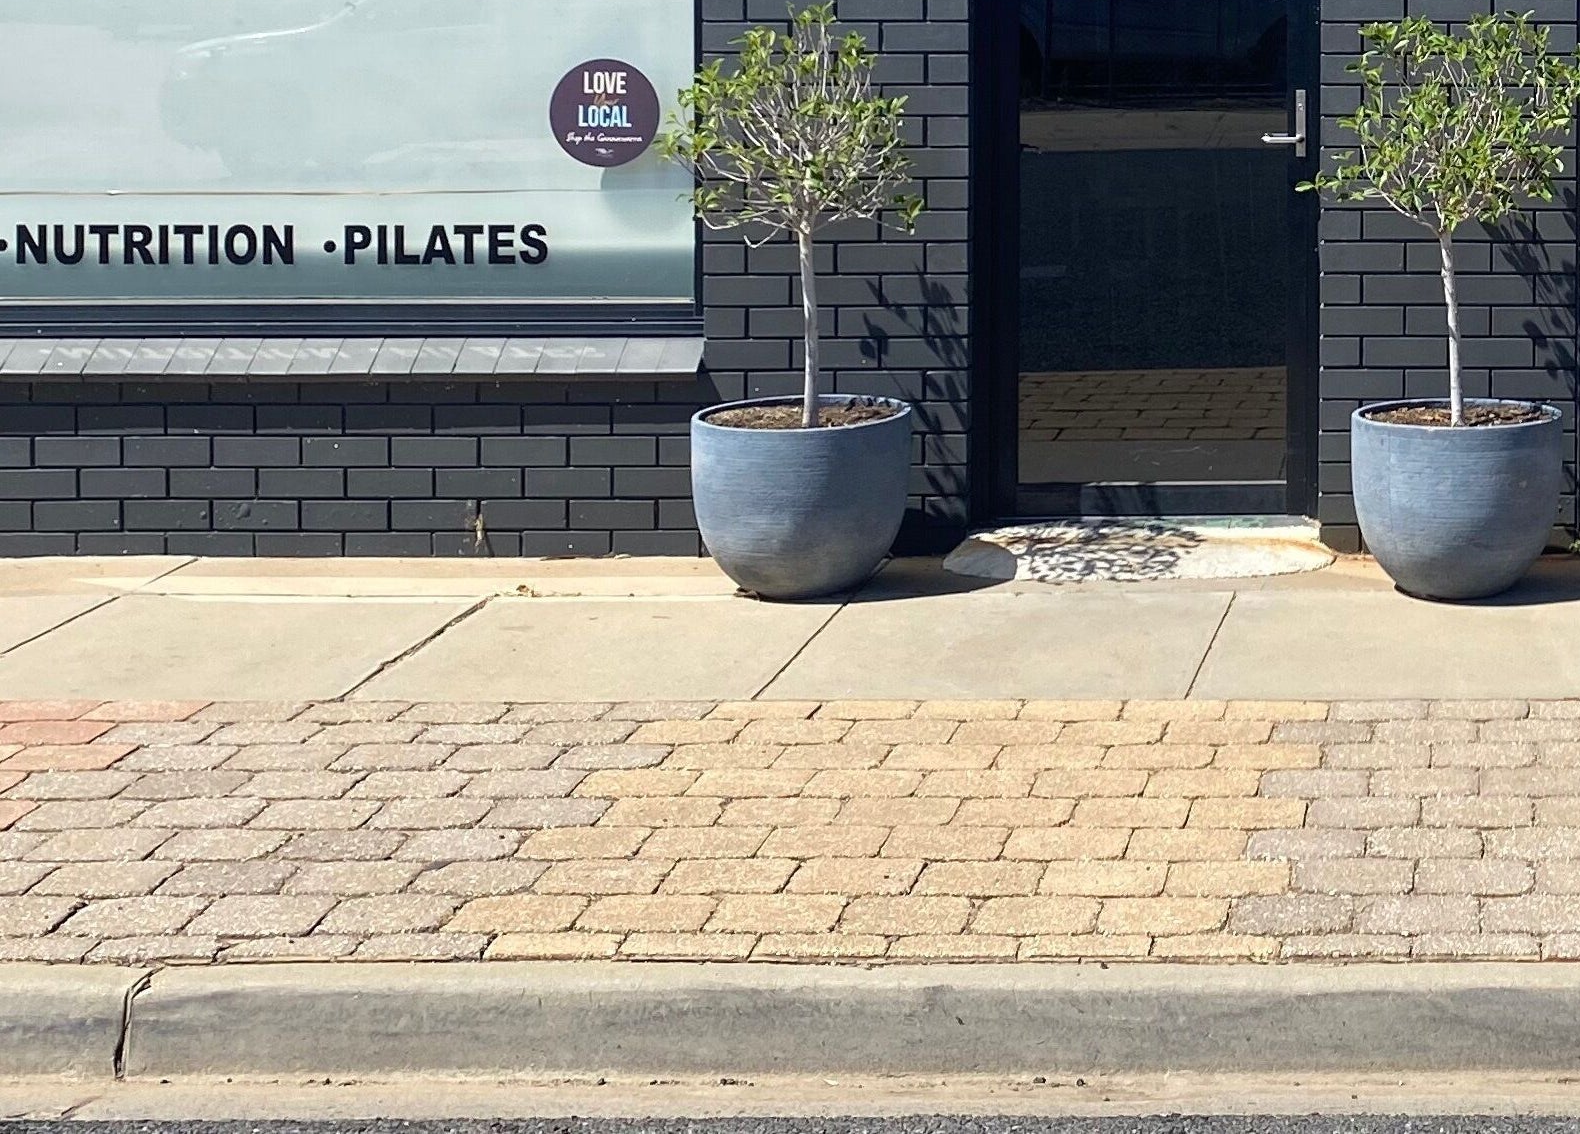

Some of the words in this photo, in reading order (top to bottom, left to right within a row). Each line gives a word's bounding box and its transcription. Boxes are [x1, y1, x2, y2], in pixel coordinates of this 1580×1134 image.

[583, 71, 627, 94] LOVE
[578, 105, 632, 128] LOCAL
[16, 224, 295, 266] NUTRITION
[344, 224, 548, 266] PILATES
